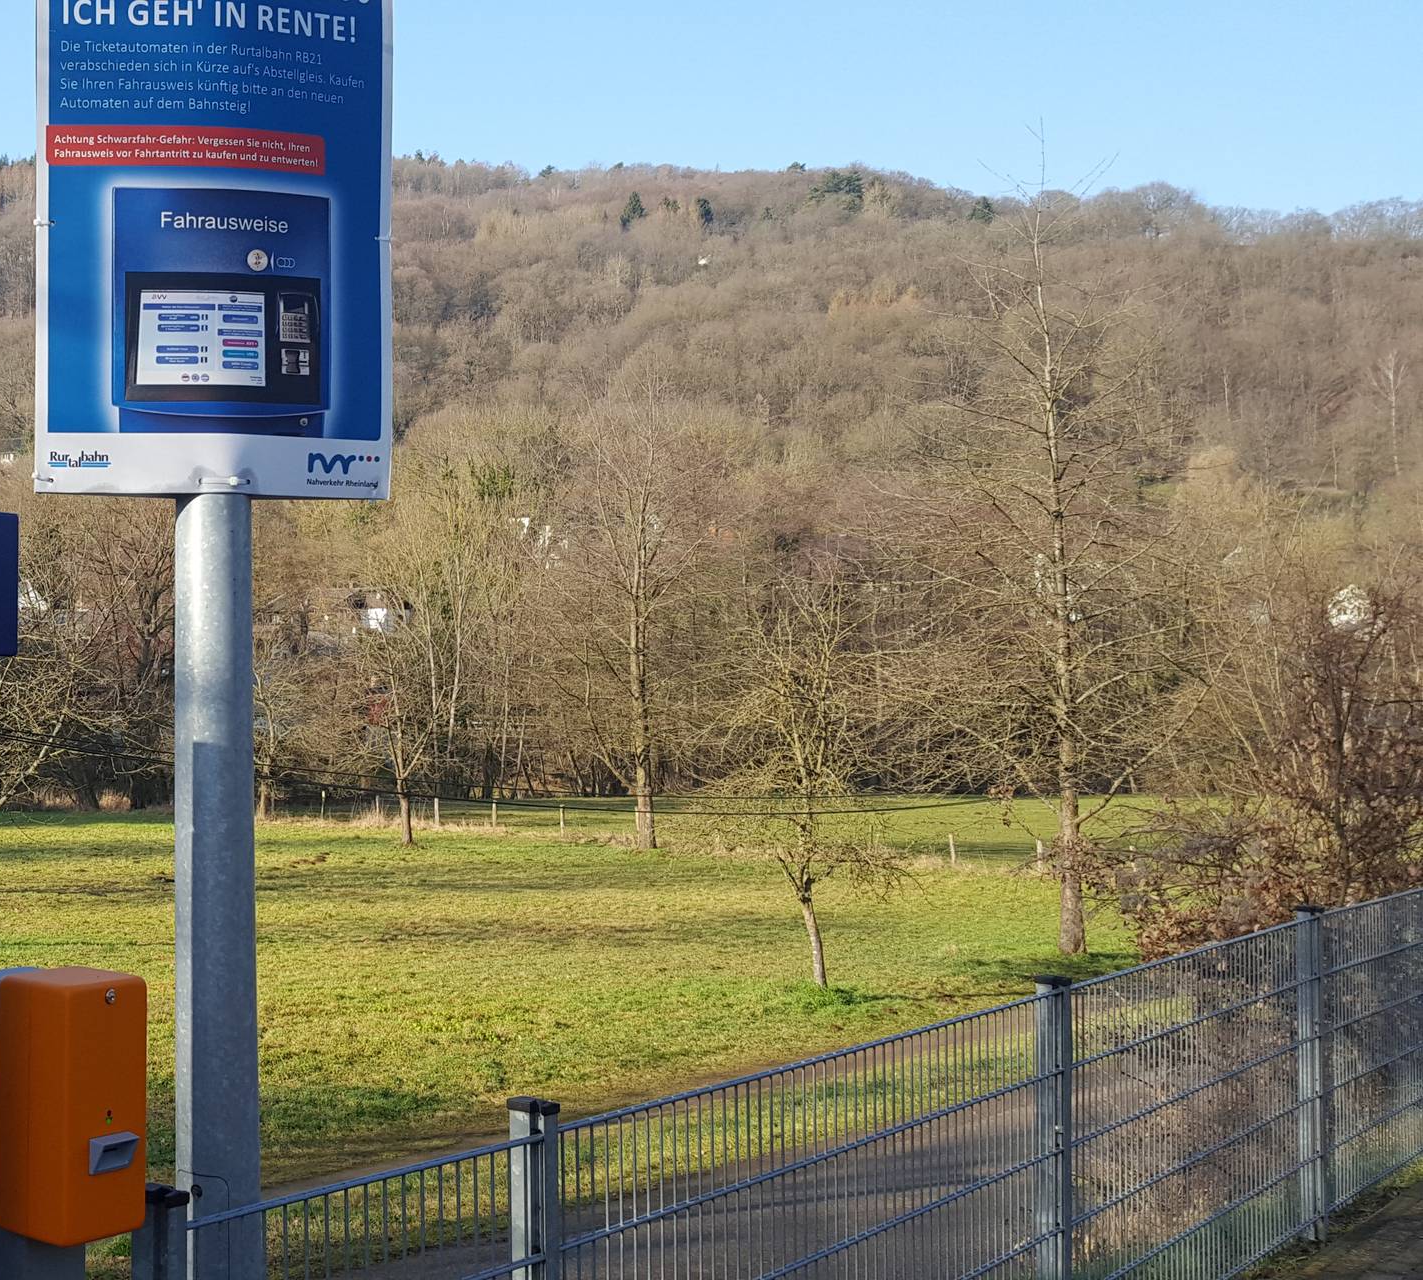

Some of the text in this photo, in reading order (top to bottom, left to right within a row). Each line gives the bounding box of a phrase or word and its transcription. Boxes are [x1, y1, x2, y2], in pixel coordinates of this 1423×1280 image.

[63, 0, 356, 43] ICH GEH' IN RENTE!
[60, 40, 322, 65] Die Ticketautomaten in der Rurtalbahn RB21
[60, 59, 365, 89] verabschieden sich in Kürze auf's Abstellgleis. Kaufen
[60, 78, 344, 104] Sie Ihren Fahrausweis künftig bitte an den neuen
[60, 97, 251, 115] Automaten auf dem Bahnsteig!
[54, 134, 311, 153] Achtung Schwarzfahr-Gefahr: Vergessen Sie nicht, Ihren
[54, 148, 114, 158] Fahrausweis
[116, 150, 132, 158] vor
[135, 148, 190, 159] Fahrtantritt
[192, 150, 203, 159] zu
[205, 149, 238, 160] kaufen
[240, 152, 257, 161] und
[271, 155, 319, 167] entwerten!
[160, 211, 289, 235] Fahrausweise
[307, 478, 379, 488] Nahverkehr Rheinland
